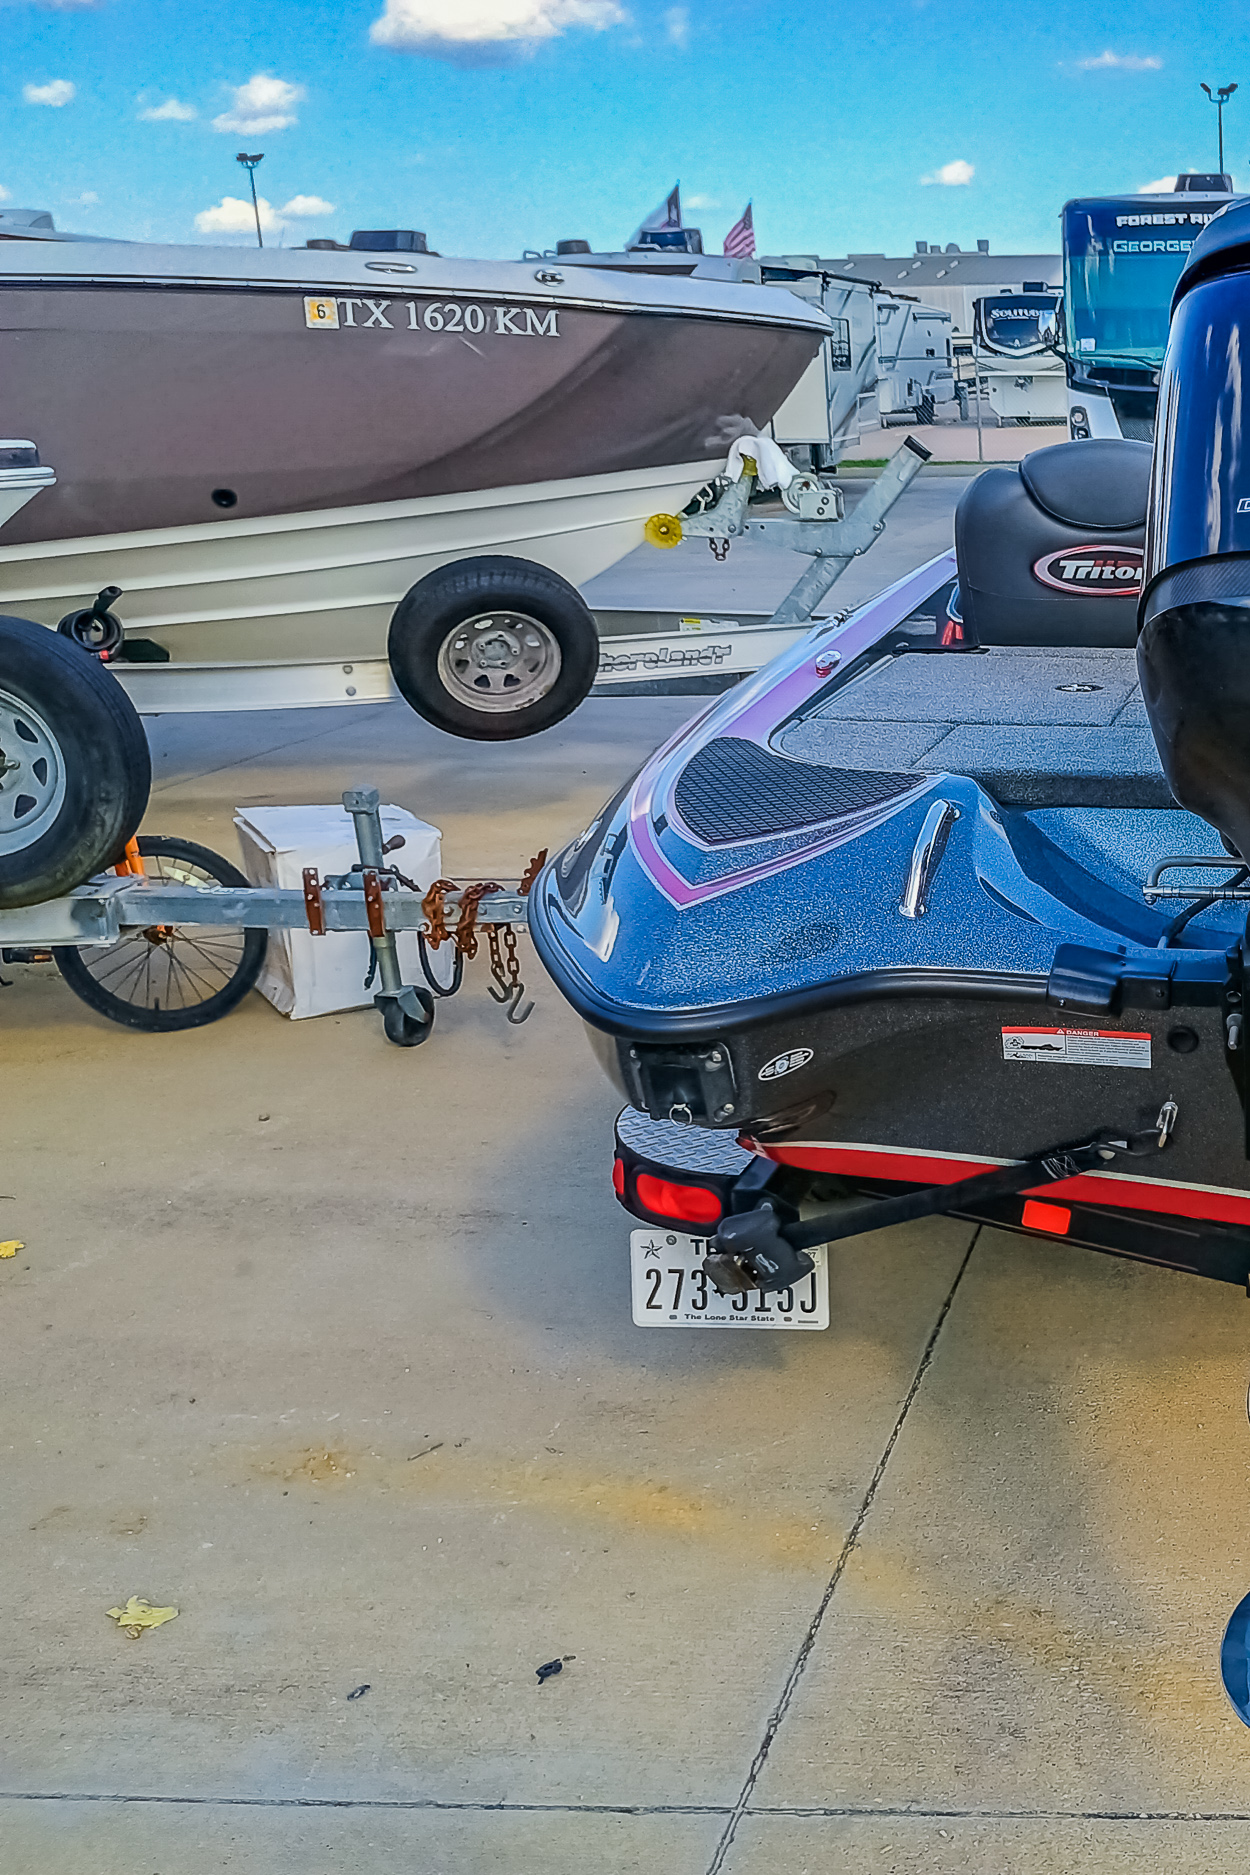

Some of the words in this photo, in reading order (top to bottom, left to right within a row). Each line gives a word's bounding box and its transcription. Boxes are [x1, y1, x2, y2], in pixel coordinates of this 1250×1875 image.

[1116, 213, 1188, 228] FOREST
[316, 304, 328, 319] 6
[337, 298, 395, 329] TX
[405, 300, 486, 334] 1620
[493, 306, 561, 336] KM
[1065, 1029, 1100, 1037] DANGER
[645, 1268, 708, 1311] 273
[729, 1314, 748, 1322] Star
